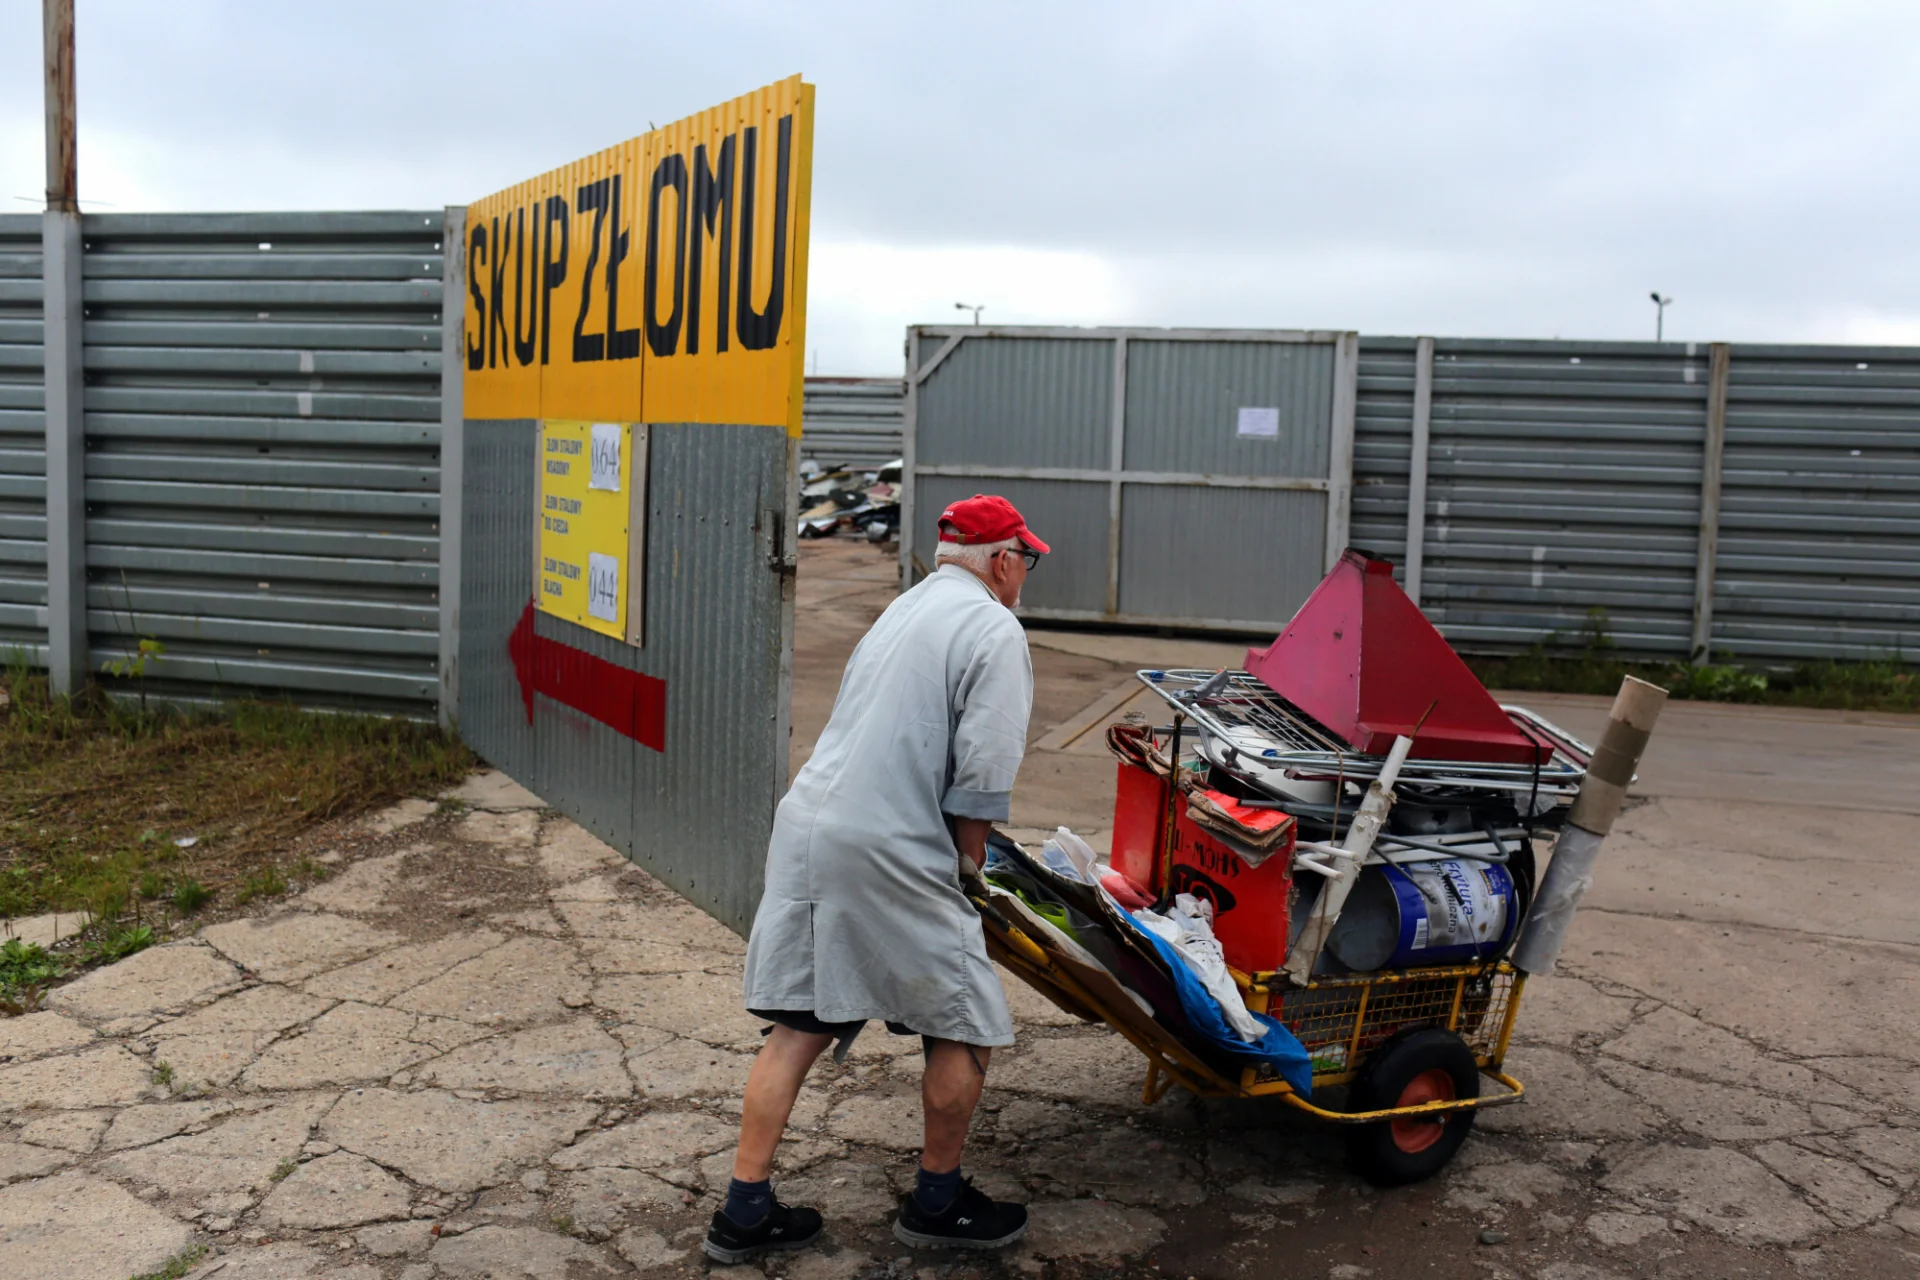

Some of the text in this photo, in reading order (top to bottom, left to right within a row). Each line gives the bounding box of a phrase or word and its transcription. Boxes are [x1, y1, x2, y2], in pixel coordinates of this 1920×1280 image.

[467, 114, 793, 371] SKUP ZŁOMU
[1441, 860, 1474, 916] Frytura
